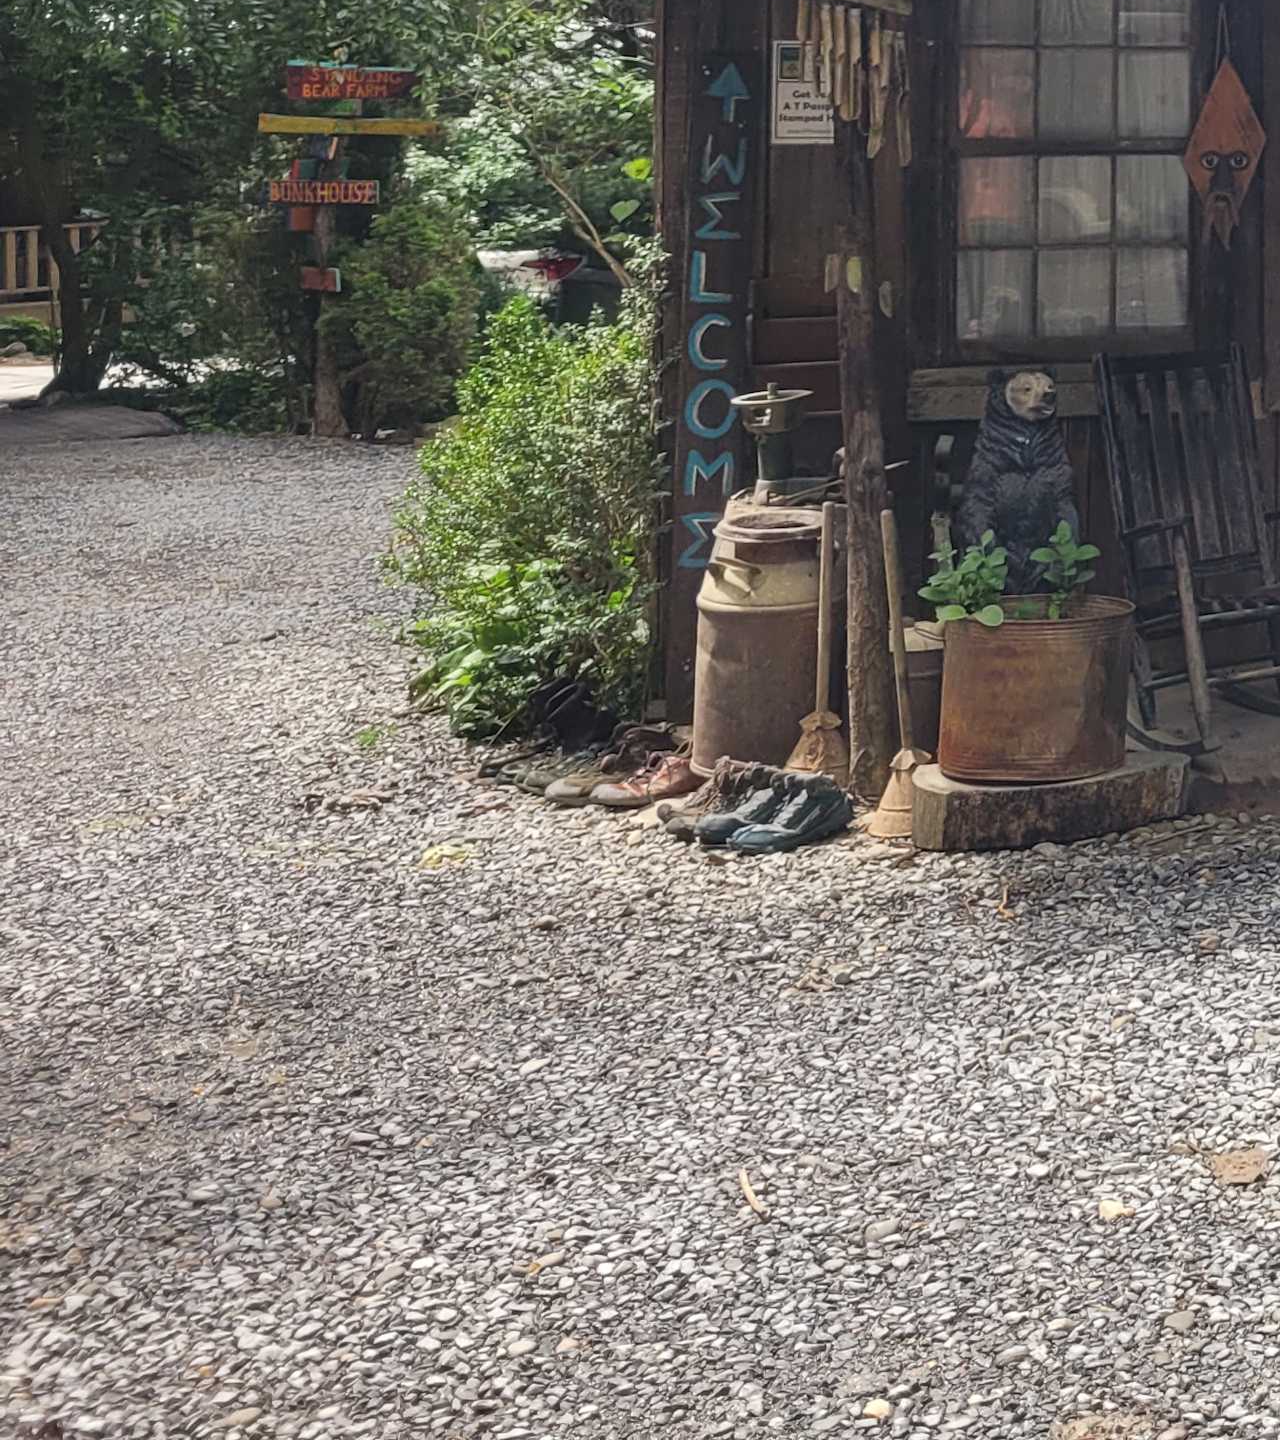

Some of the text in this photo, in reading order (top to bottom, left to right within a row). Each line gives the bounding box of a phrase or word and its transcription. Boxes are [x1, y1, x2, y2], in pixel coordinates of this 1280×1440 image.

[303, 84, 387, 98] BEAR FARM
[783, 102, 791, 110] A
[803, 102, 833, 111] Passp
[269, 181, 376, 203] BUNKHOUSE
[678, 133, 746, 568] WELCOME
